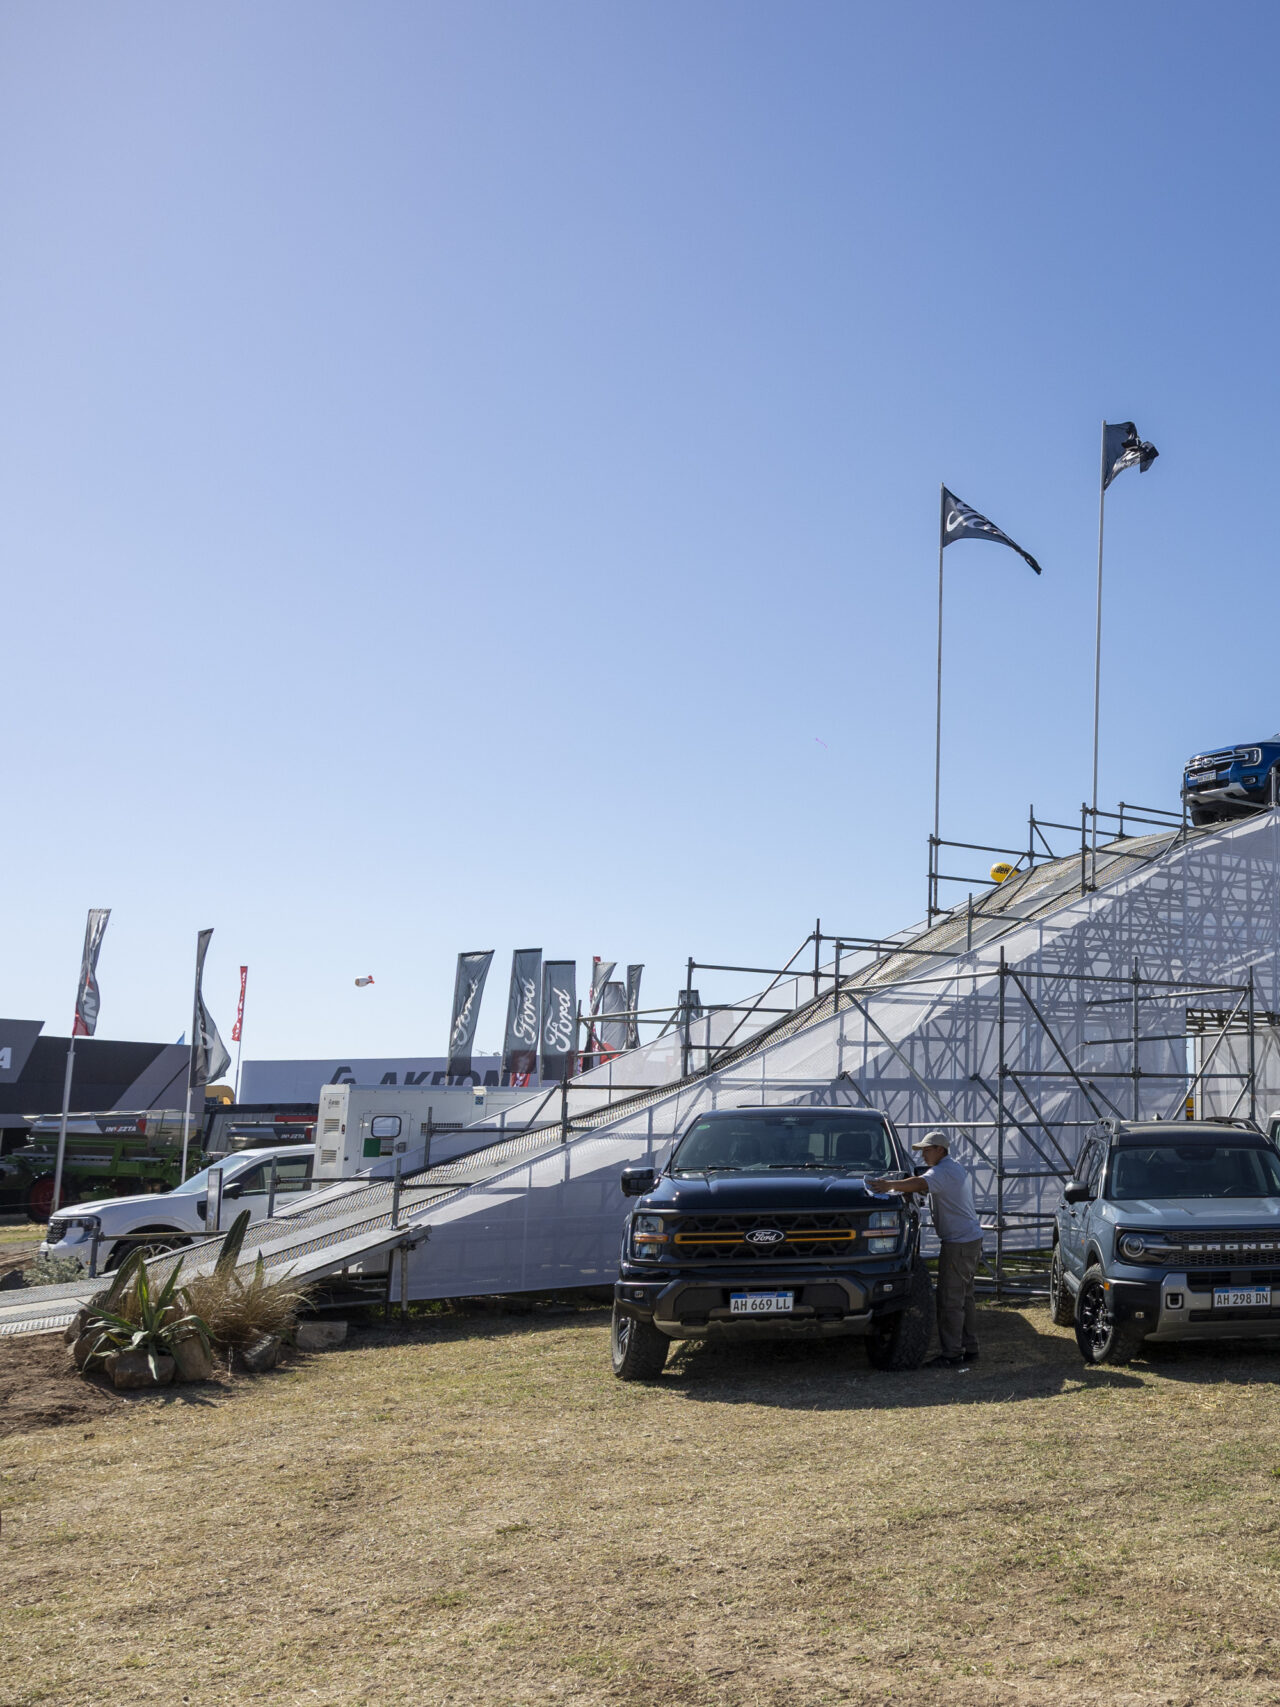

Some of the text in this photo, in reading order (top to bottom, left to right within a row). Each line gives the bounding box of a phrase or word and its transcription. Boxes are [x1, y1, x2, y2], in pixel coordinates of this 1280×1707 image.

[513, 977, 536, 1045] Ford
[545, 987, 571, 1052] Ford
[752, 1231, 777, 1242] Ford
[733, 1298, 790, 1311] AH 669 LL
[1216, 1292, 1268, 1306] AH 298 DN
